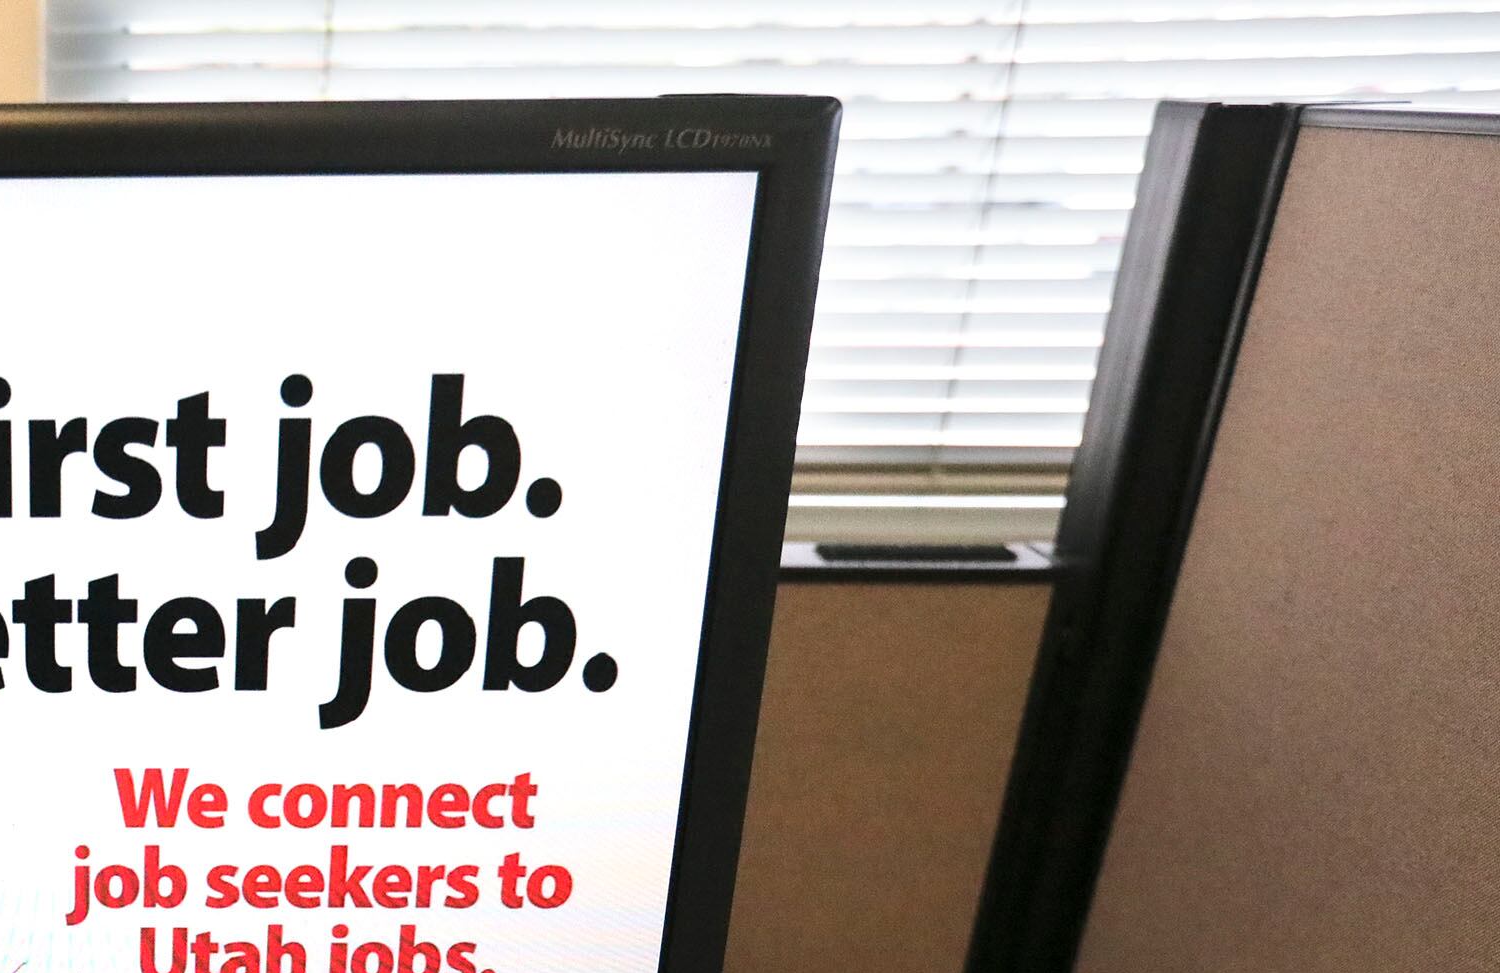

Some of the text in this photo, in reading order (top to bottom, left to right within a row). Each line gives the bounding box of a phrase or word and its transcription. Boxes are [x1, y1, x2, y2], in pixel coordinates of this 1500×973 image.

[551, 128, 657, 155] MultiSync
[255, 373, 563, 561] job.
[318, 556, 619, 730] job.
[113, 767, 538, 830] We connect
[66, 845, 574, 926] job seekers to
